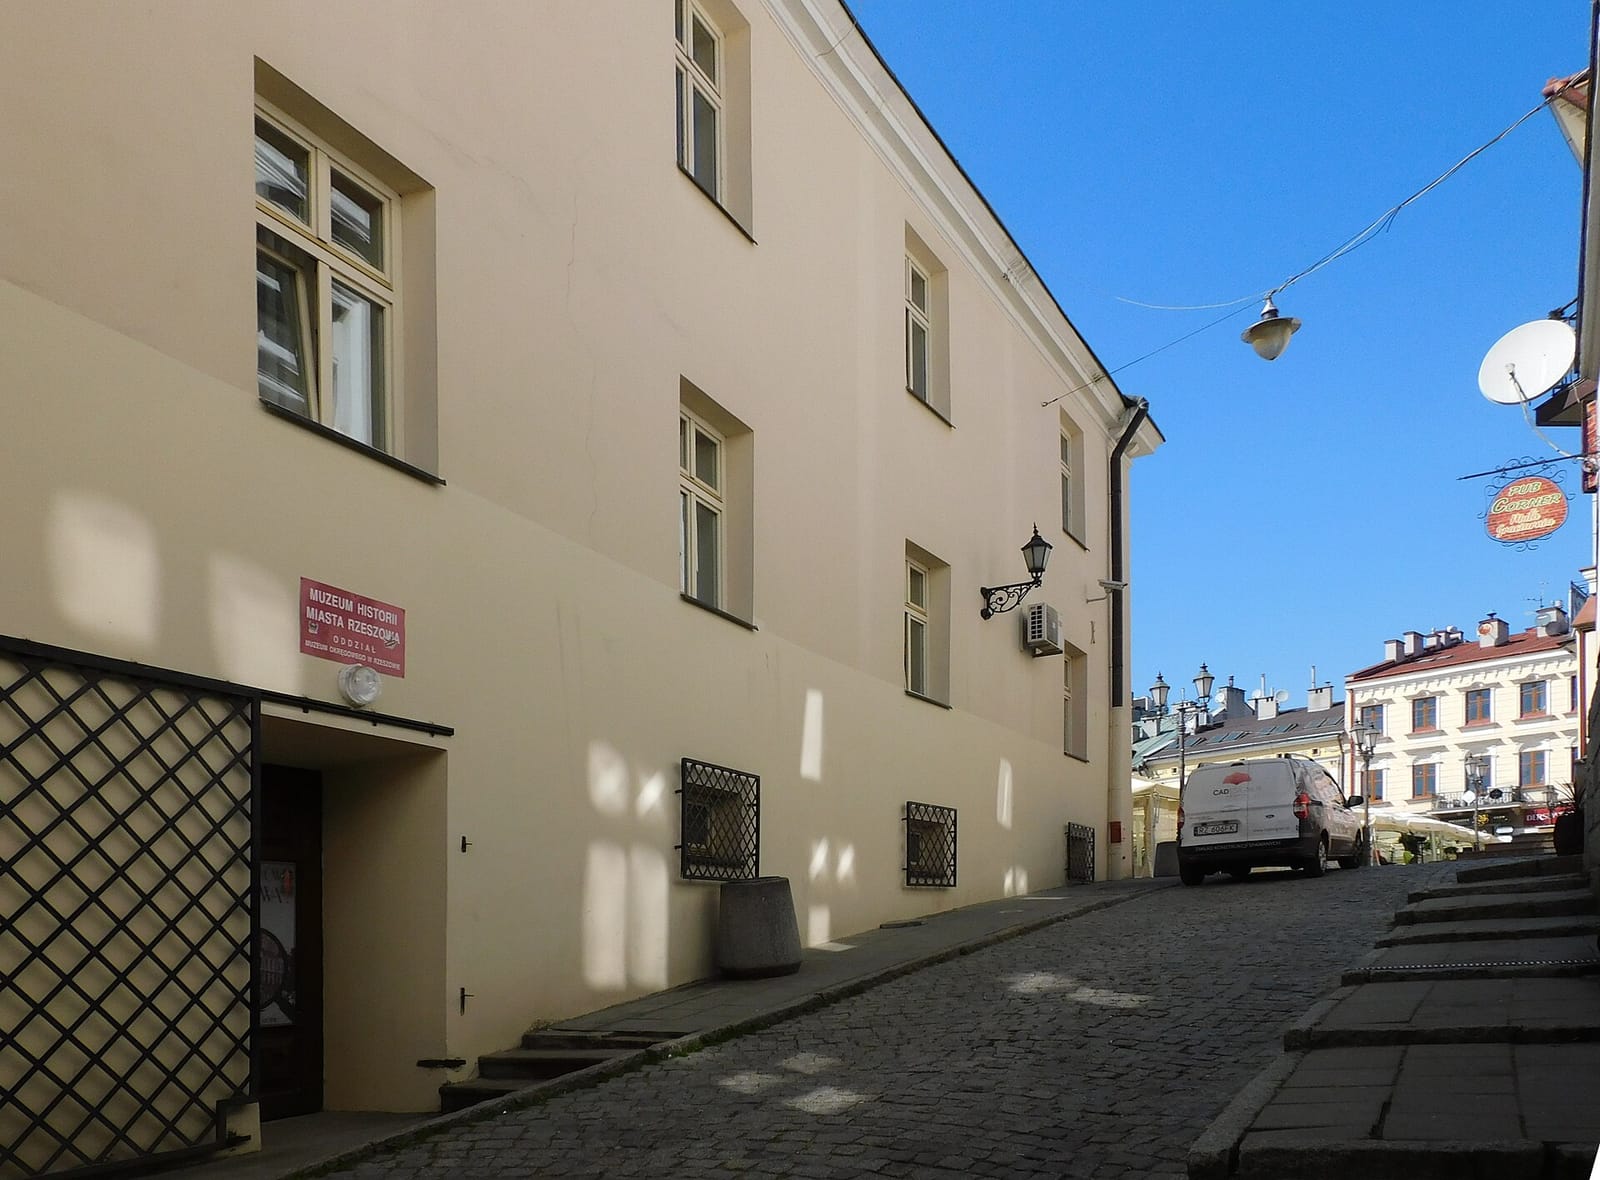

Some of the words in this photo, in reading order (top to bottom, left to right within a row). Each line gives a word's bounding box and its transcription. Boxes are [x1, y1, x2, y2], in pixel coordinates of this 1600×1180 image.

[1508, 482, 1542, 496] PUB
[310, 588, 353, 612] MUZEUM
[357, 603, 398, 625] HISTORII
[306, 606, 344, 628] MIASTA
[347, 619, 400, 644] RZESZOWA
[333, 635, 377, 653] ODDZIAŁ
